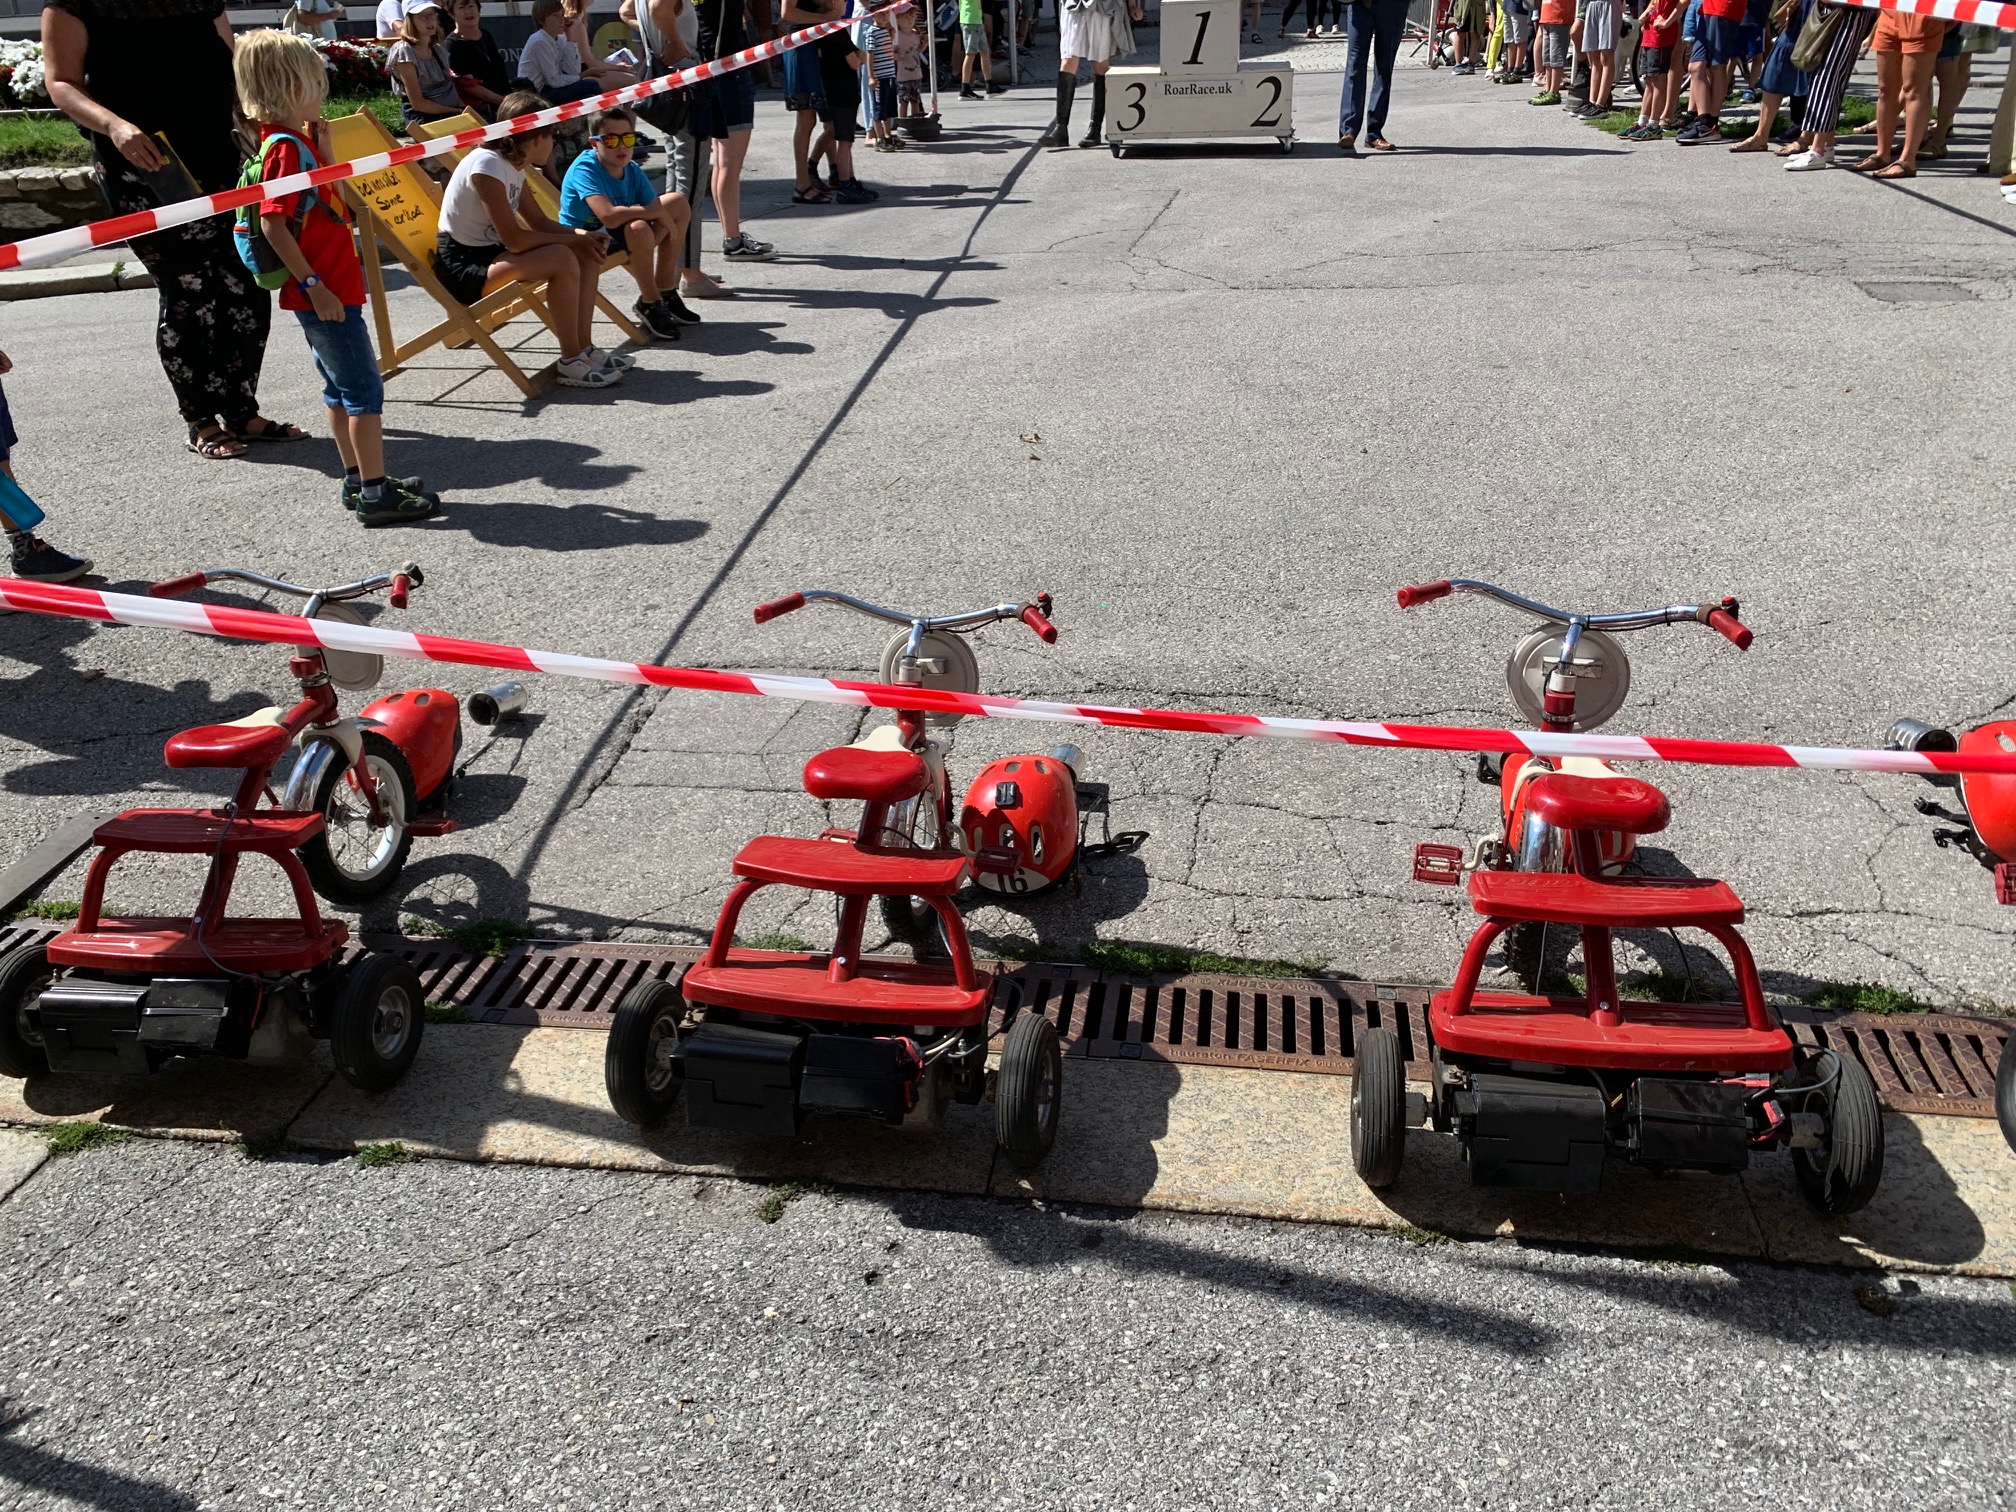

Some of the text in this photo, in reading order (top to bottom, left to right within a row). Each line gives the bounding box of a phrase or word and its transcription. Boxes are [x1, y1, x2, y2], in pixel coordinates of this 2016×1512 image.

[1182, 10, 1212, 65] 1
[1116, 82, 1147, 132] 3
[1163, 81, 1233, 96] RoarRace.uk
[1250, 75, 1283, 127] 2
[996, 867, 1029, 893] 16
[1914, 1099, 1988, 1112] hauraton
